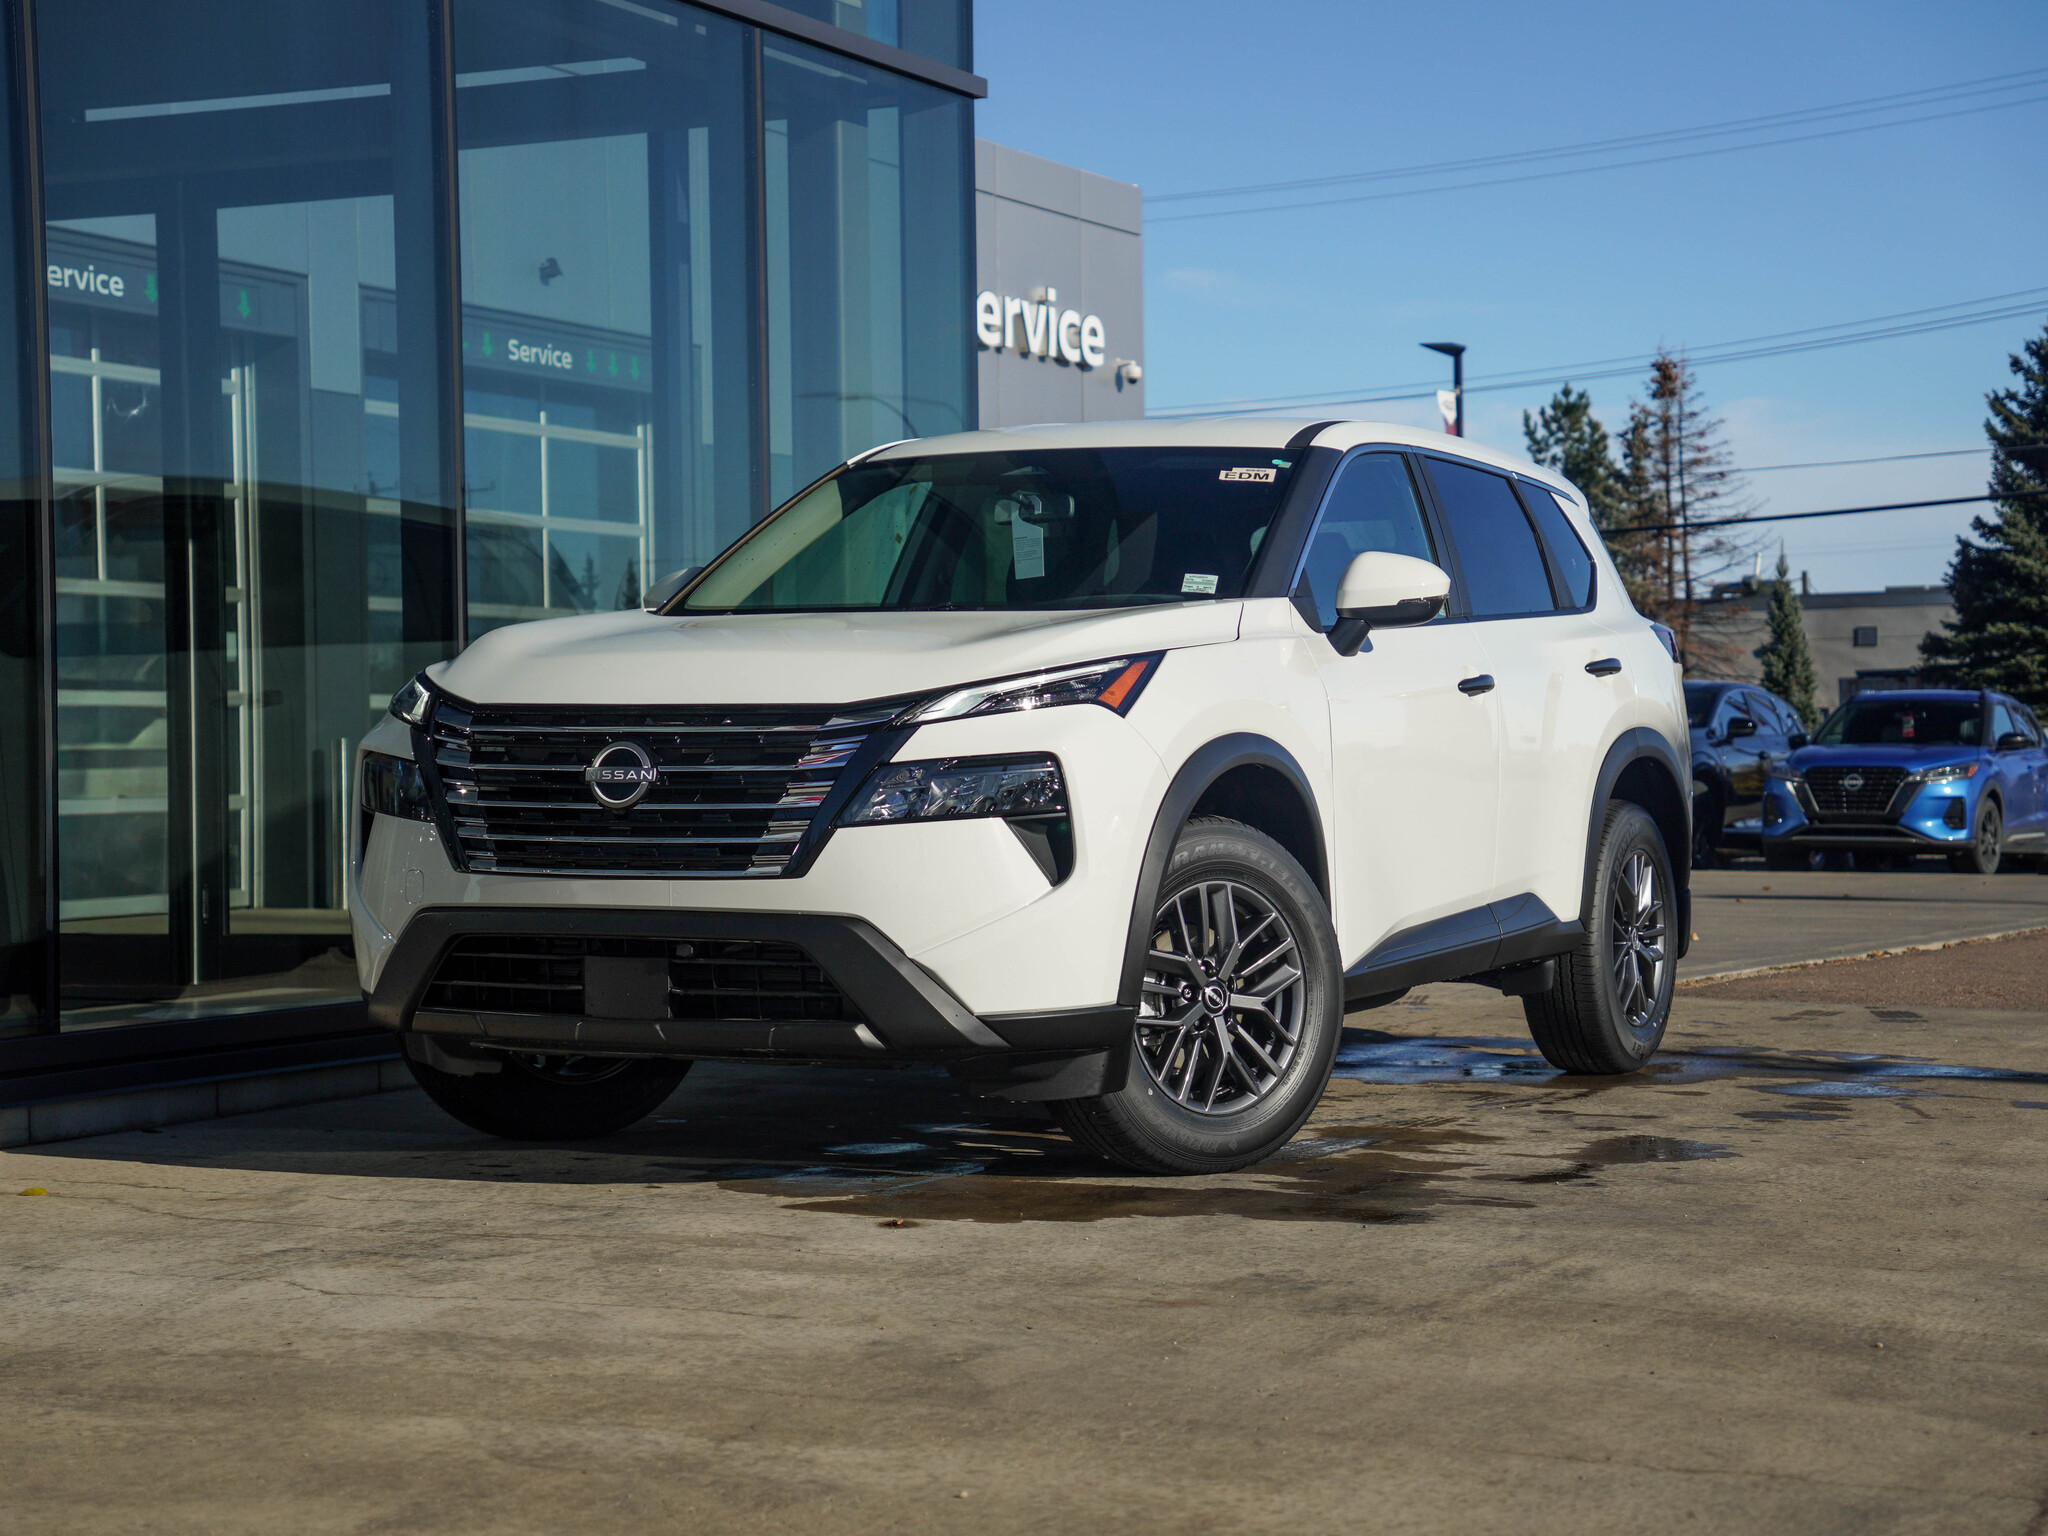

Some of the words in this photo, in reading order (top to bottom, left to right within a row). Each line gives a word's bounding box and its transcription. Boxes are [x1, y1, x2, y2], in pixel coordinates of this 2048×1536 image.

[47, 264, 124, 297] ervice
[976, 286, 1105, 368] ervice
[508, 338, 573, 370] Service
[1224, 471, 1270, 480] EDM
[586, 769, 653, 780] NISSAN
